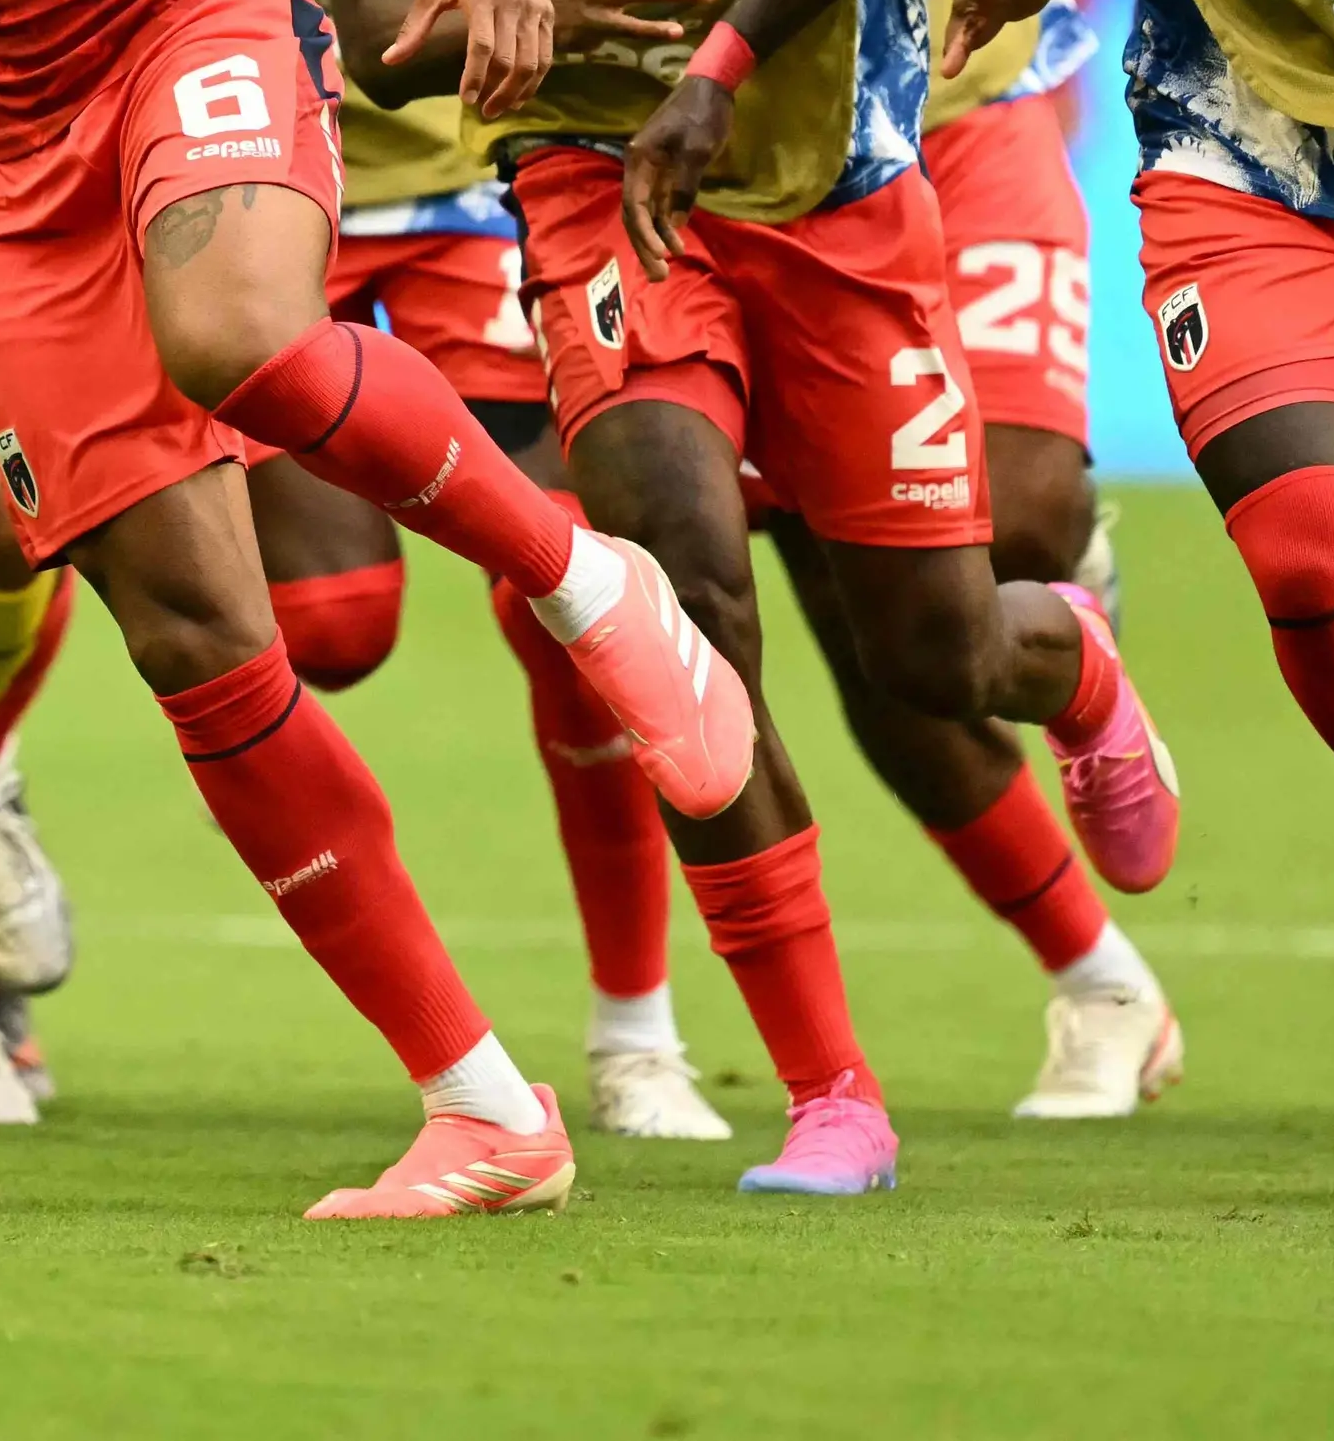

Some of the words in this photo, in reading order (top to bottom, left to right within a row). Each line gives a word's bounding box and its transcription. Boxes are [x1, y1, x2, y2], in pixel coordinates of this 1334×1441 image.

[173, 54, 271, 138] 6
[186, 137, 281, 160] capelli
[1162, 286, 1194, 321] FCF
[890, 346, 967, 469] 2
[891, 475, 969, 507] capelli
[262, 849, 338, 896] apelli
